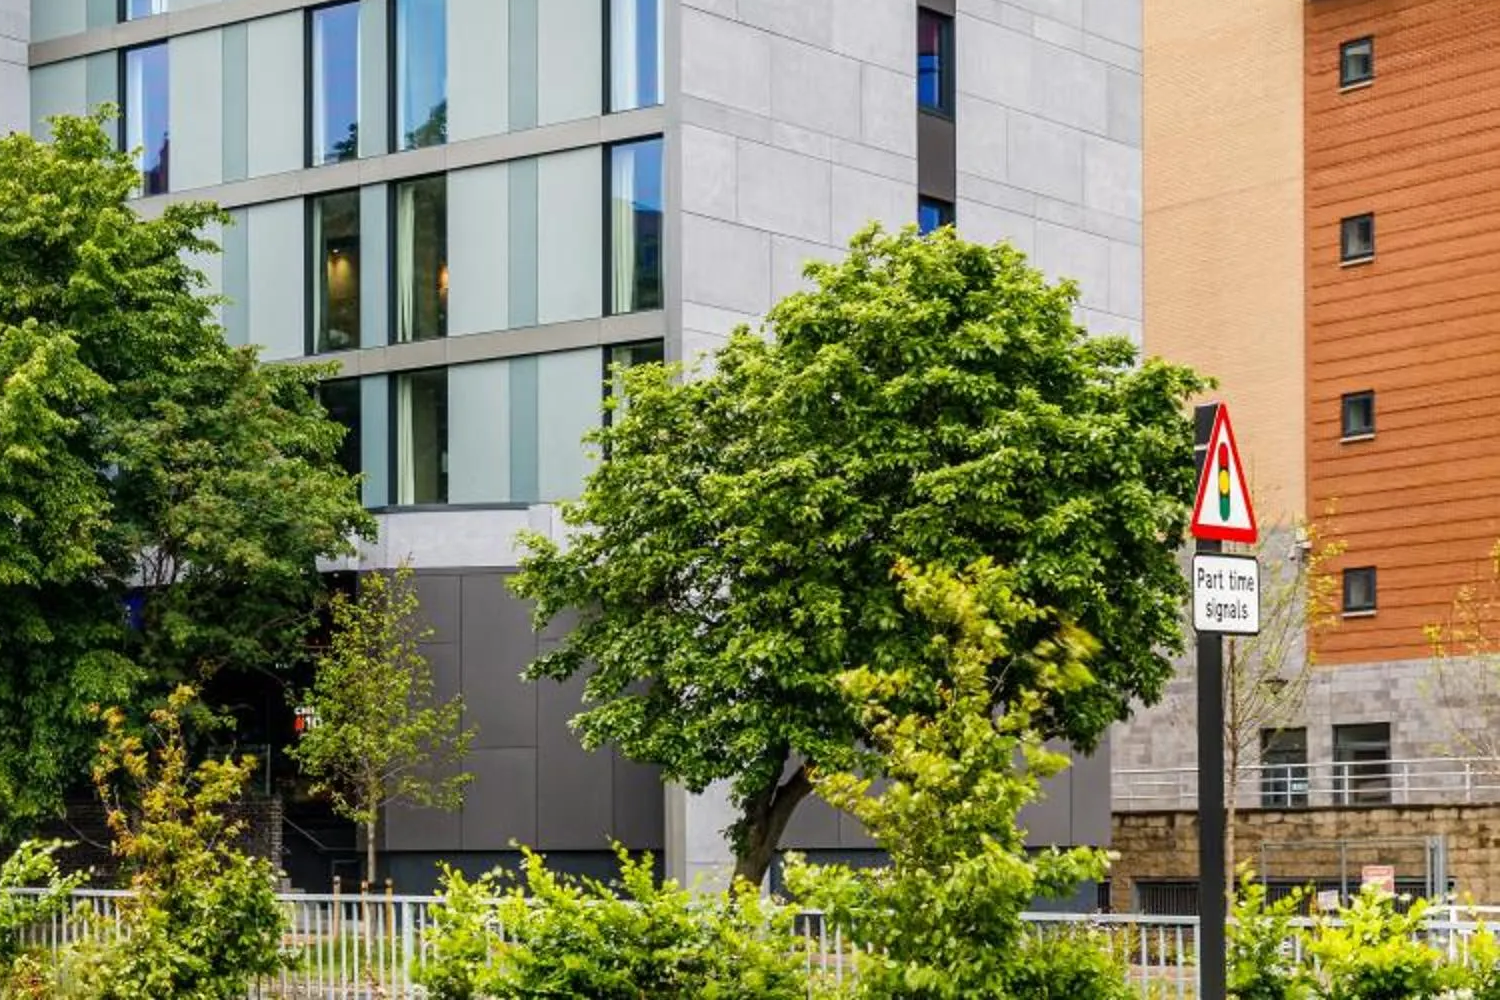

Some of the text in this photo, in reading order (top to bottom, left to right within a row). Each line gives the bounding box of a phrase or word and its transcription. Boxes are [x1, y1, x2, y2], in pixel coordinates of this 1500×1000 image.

[1197, 566, 1255, 592] Part time
[1205, 596, 1250, 623] signals
